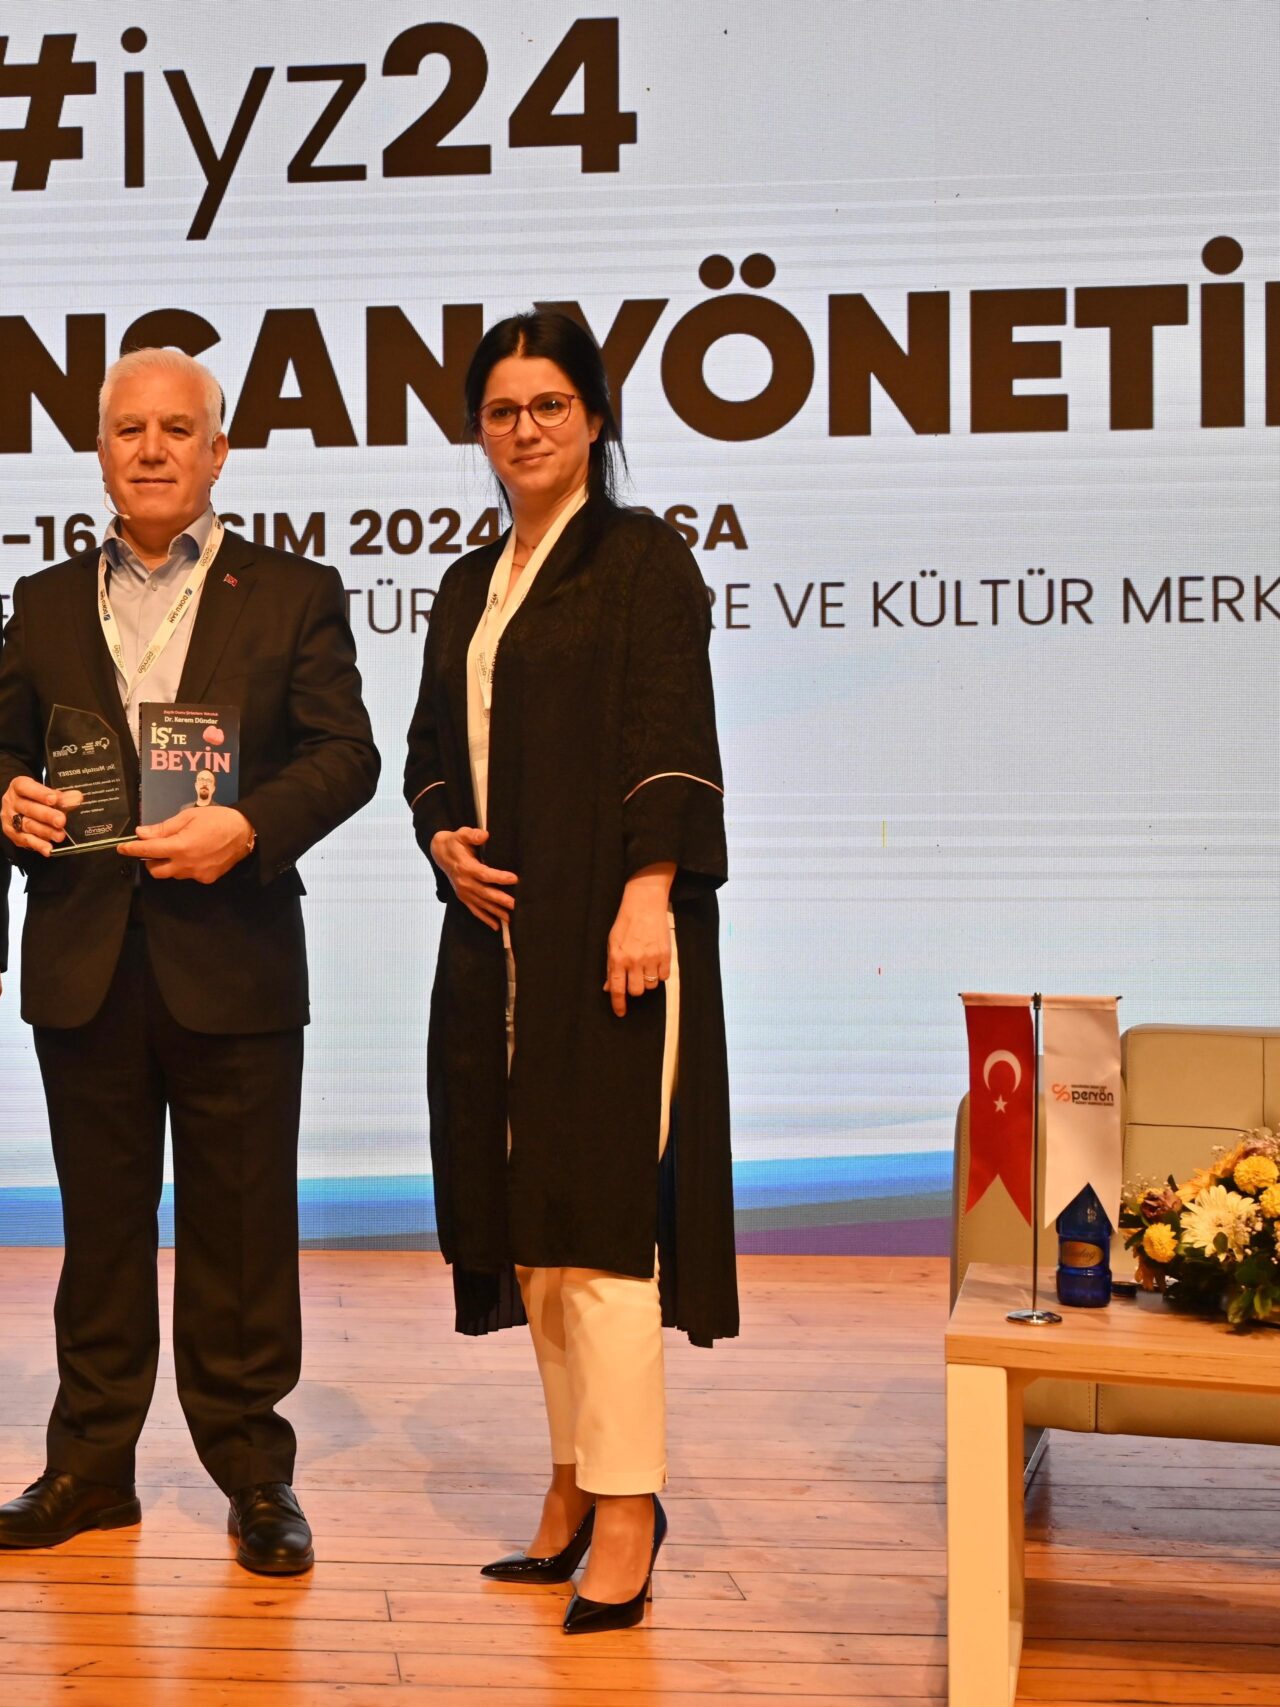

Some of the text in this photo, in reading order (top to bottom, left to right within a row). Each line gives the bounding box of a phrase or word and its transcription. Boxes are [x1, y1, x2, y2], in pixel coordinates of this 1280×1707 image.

[533, 235, 1280, 442] YÖNETİ
[349, 507, 502, 555] 2024
[773, 581, 846, 629] VE
[872, 568, 1094, 628] KÜLTÜR
[174, 716, 194, 724] Kerem
[194, 717, 219, 725] Dündar
[150, 746, 231, 773] BEYİN
